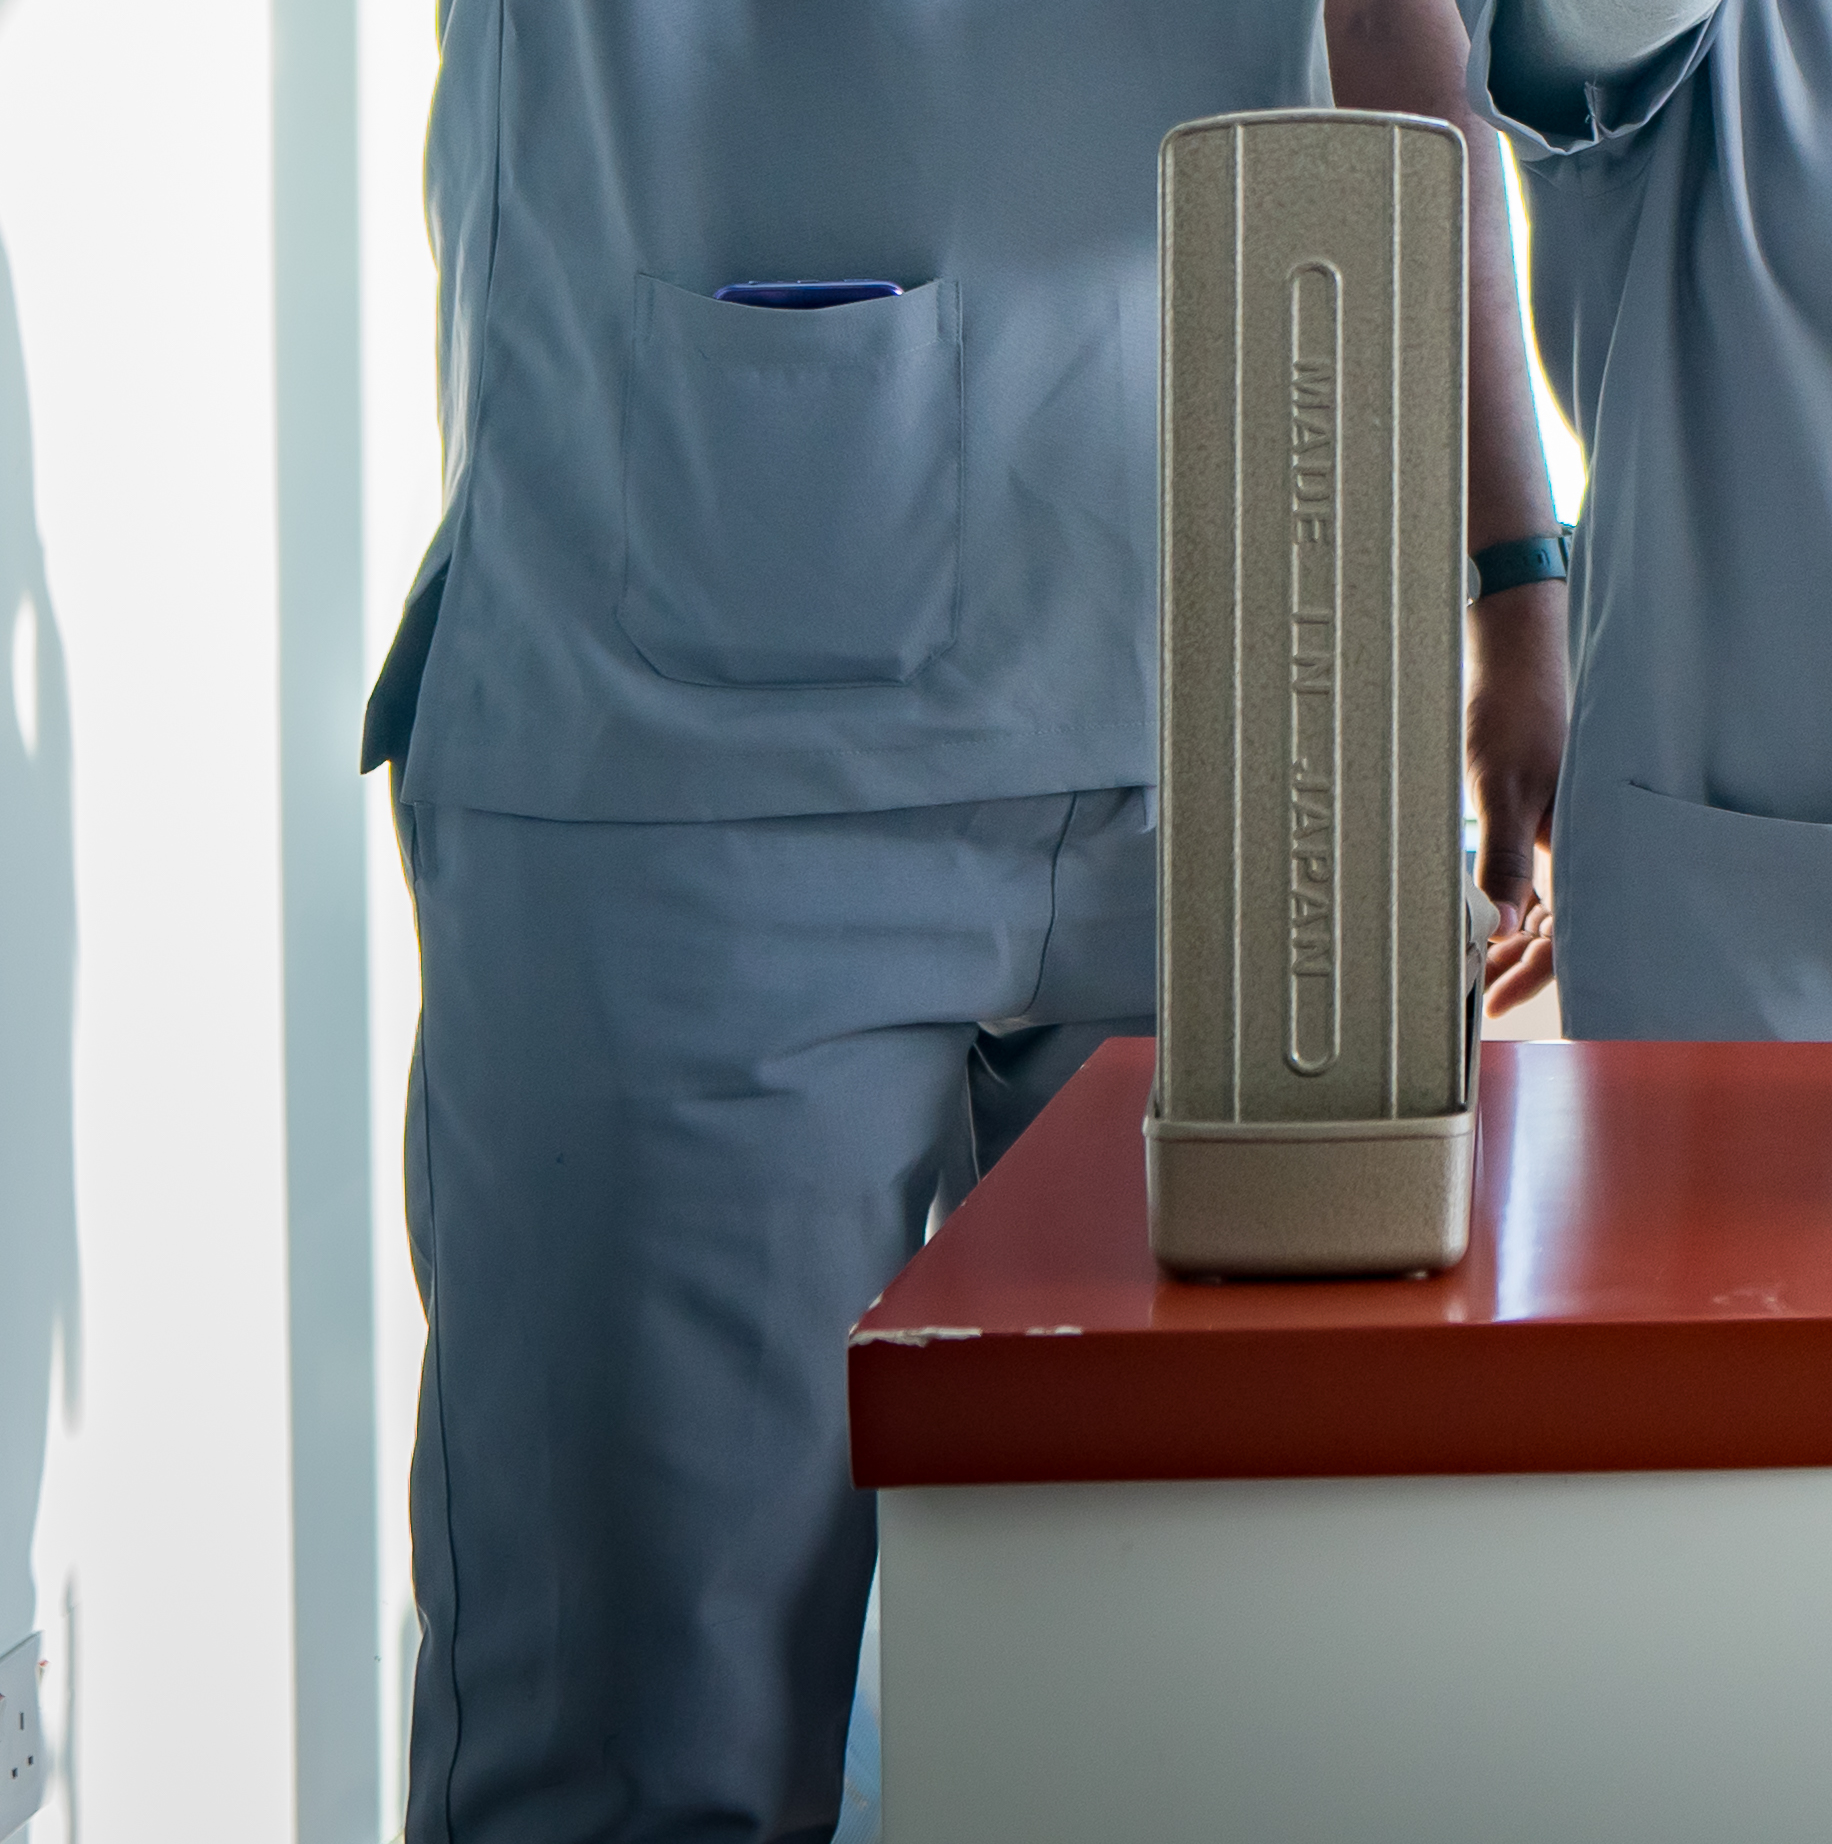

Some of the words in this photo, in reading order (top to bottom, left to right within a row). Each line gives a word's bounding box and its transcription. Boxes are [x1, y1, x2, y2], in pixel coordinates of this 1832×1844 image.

[1290, 356, 1335, 546] MADE
[1290, 609, 1335, 698] IN
[1290, 757, 1335, 979] JAPAN
